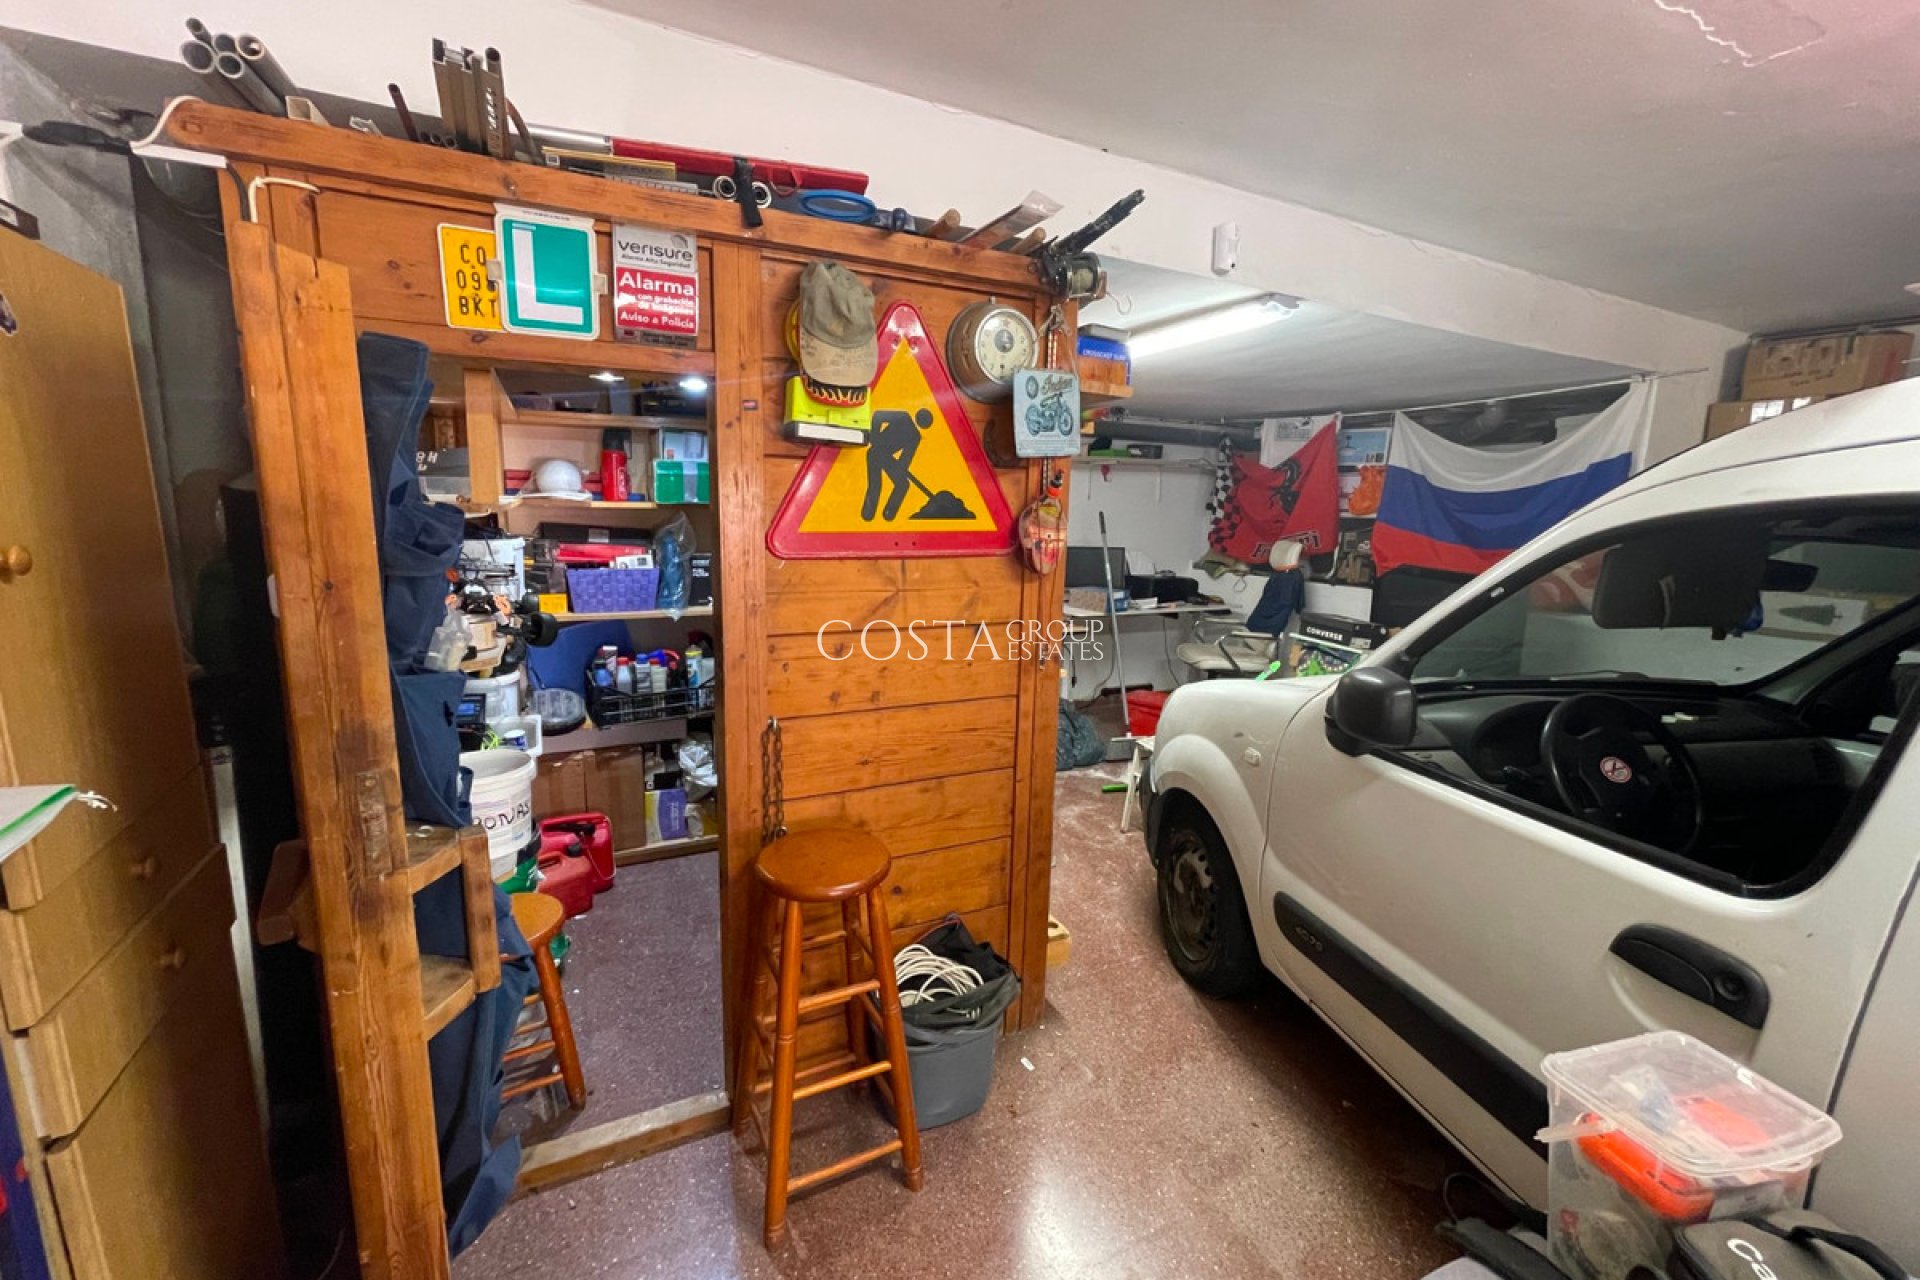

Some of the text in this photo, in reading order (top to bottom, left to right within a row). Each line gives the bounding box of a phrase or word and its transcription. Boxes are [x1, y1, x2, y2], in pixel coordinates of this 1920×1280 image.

[618, 240, 693, 261] verisure
[511, 223, 584, 326] L
[619, 271, 694, 297] Alarma
[459, 296, 497, 318] BKT
[620, 311, 650, 323] Aviso
